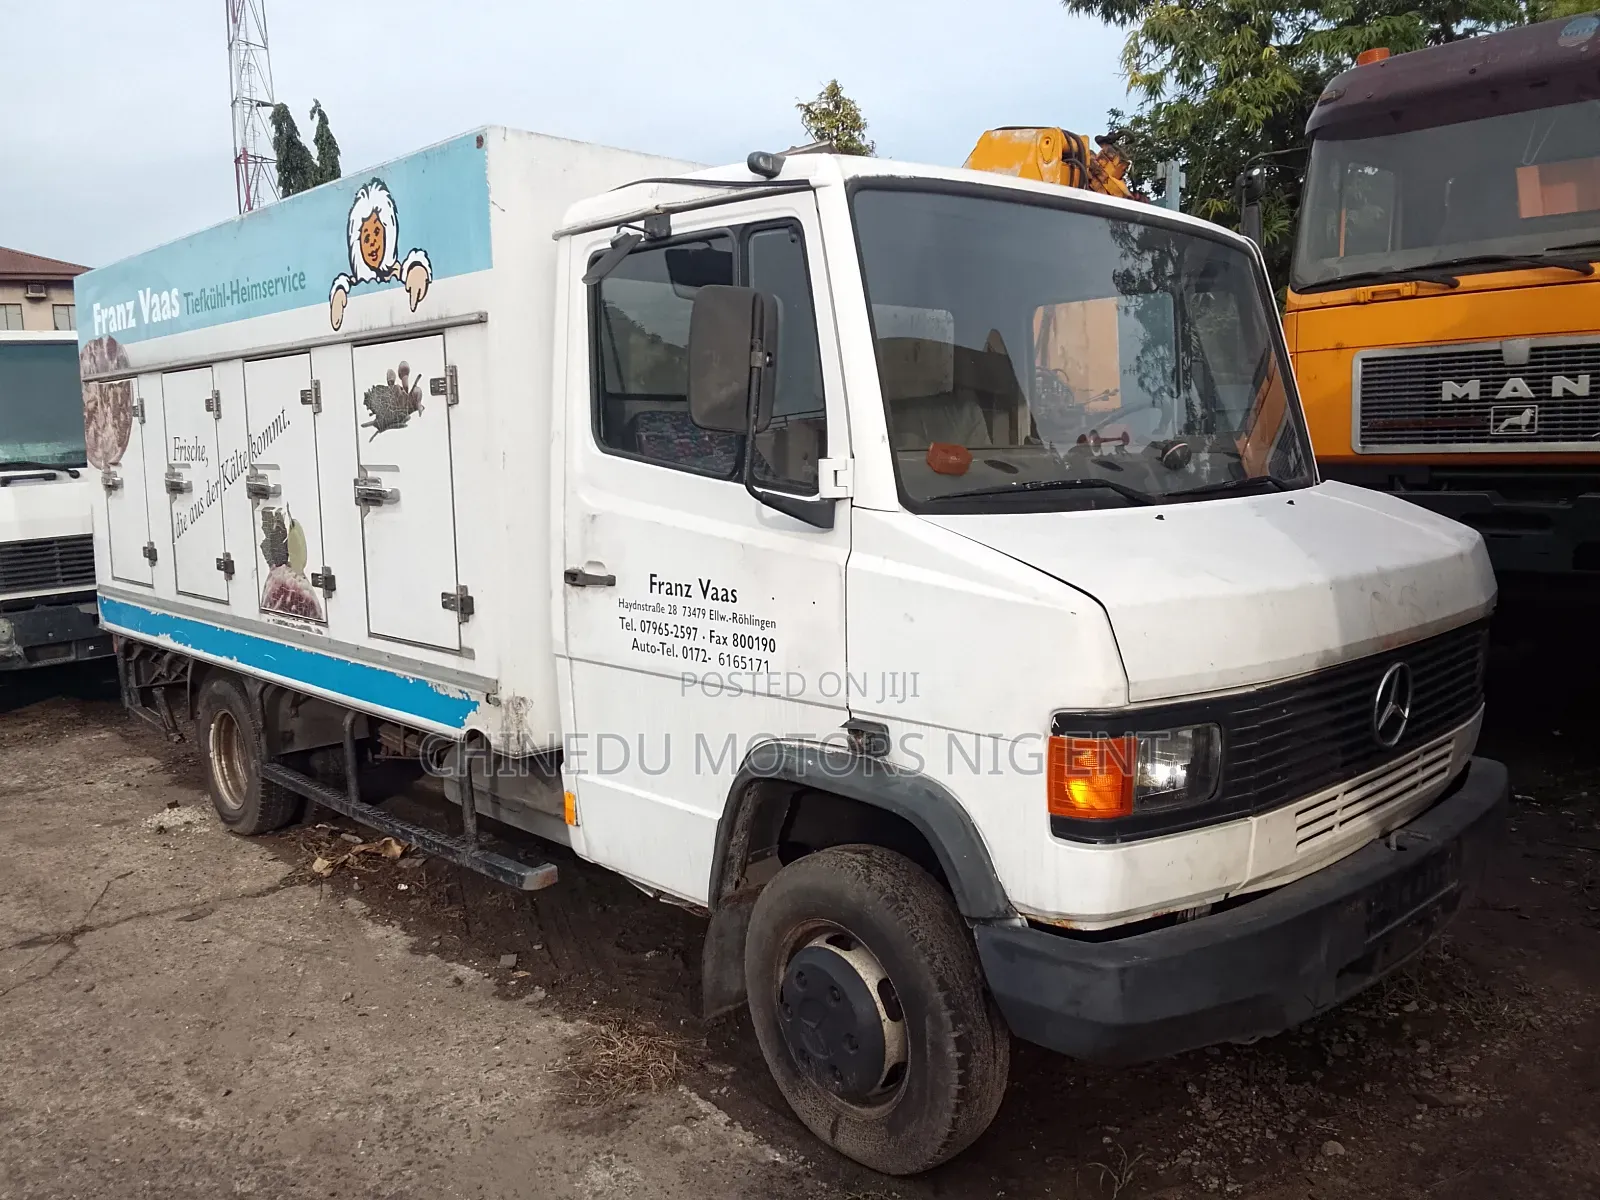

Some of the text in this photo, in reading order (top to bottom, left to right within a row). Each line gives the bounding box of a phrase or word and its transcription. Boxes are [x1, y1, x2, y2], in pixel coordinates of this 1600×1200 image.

[92, 266, 306, 336] Franz Vaas Tiefkühl-Heimservice
[1442, 374, 1590, 401] MAN
[173, 435, 209, 467] Frische,
[175, 408, 291, 539] die aus der Kälte kommt.
[649, 573, 738, 603] Franz Vaas
[618, 598, 777, 631] Haydnstraße 28 73479 Ellw.-Röhlingen
[618, 616, 776, 653] Tel. 07965-2597 Fax 800190
[631, 637, 769, 674] Auto-Tel. 0172- 6165171
